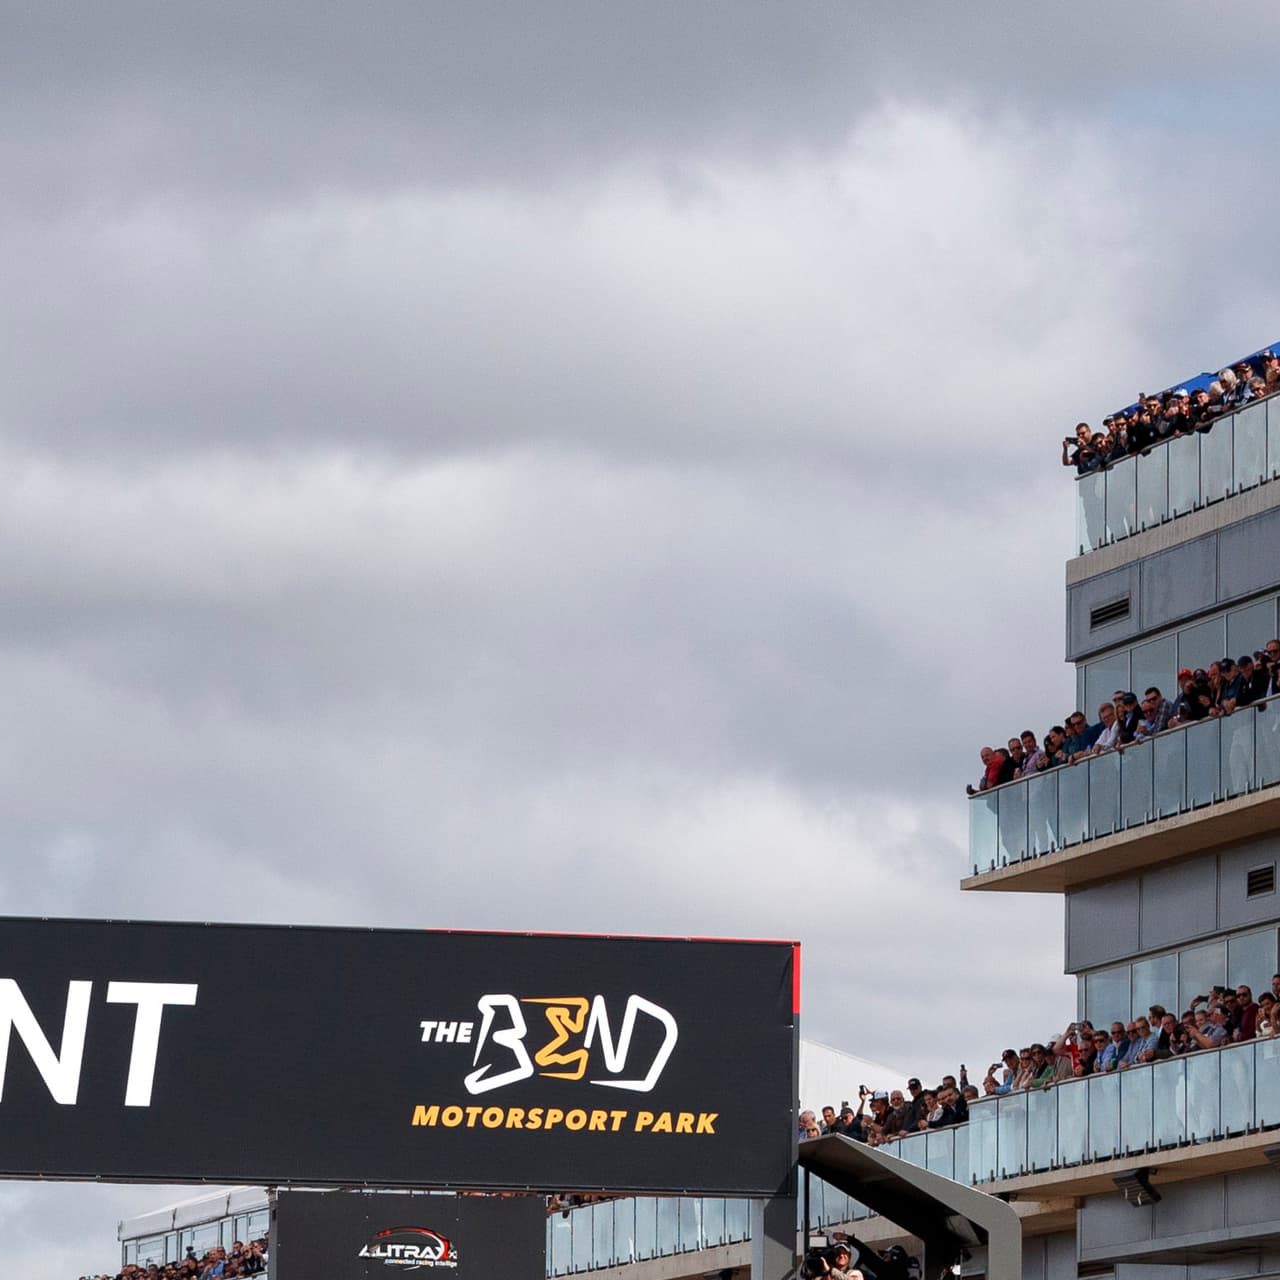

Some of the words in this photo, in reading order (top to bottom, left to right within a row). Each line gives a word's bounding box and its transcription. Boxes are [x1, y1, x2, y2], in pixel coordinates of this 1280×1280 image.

[420, 1020, 474, 1044] THE
[463, 993, 679, 1095] BEND
[411, 1104, 628, 1133] MOTORSPORT
[634, 1110, 721, 1135] PARK
